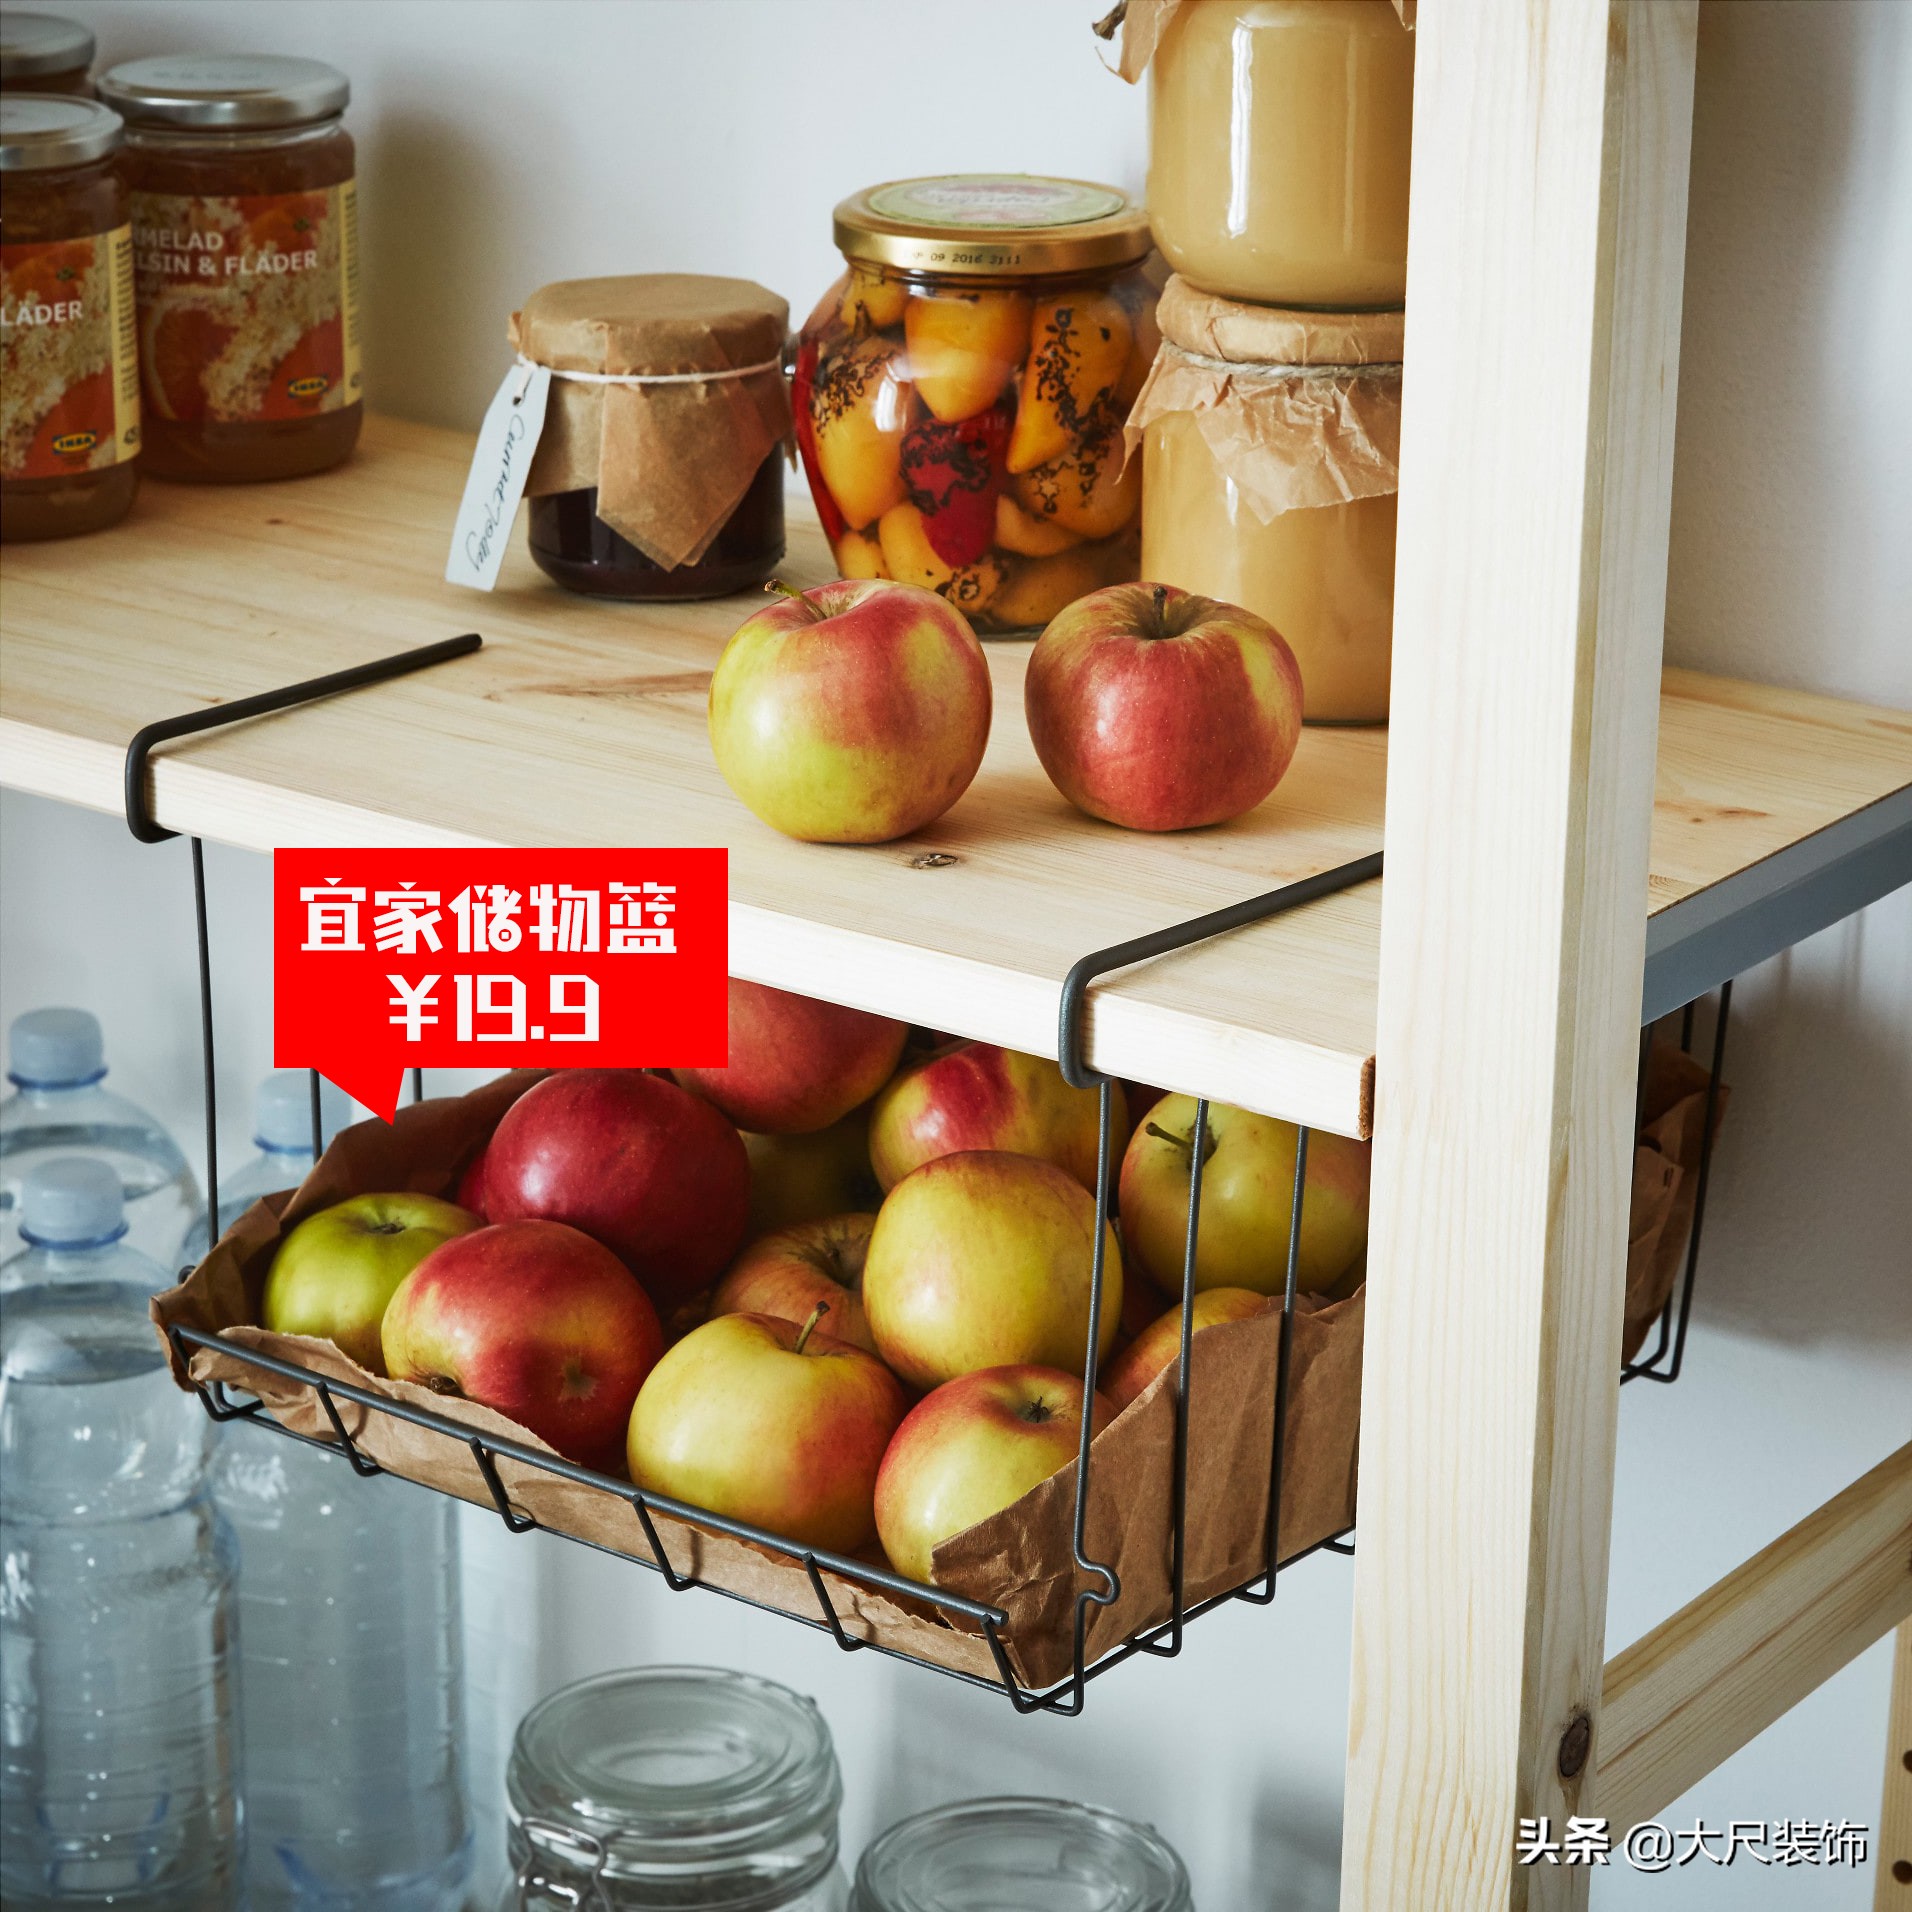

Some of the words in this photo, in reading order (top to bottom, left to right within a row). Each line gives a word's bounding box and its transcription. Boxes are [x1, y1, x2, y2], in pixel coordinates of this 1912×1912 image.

[197, 255, 217, 276] &
[224, 248, 318, 277] FLÄDER
[952, 253, 983, 265] 2016
